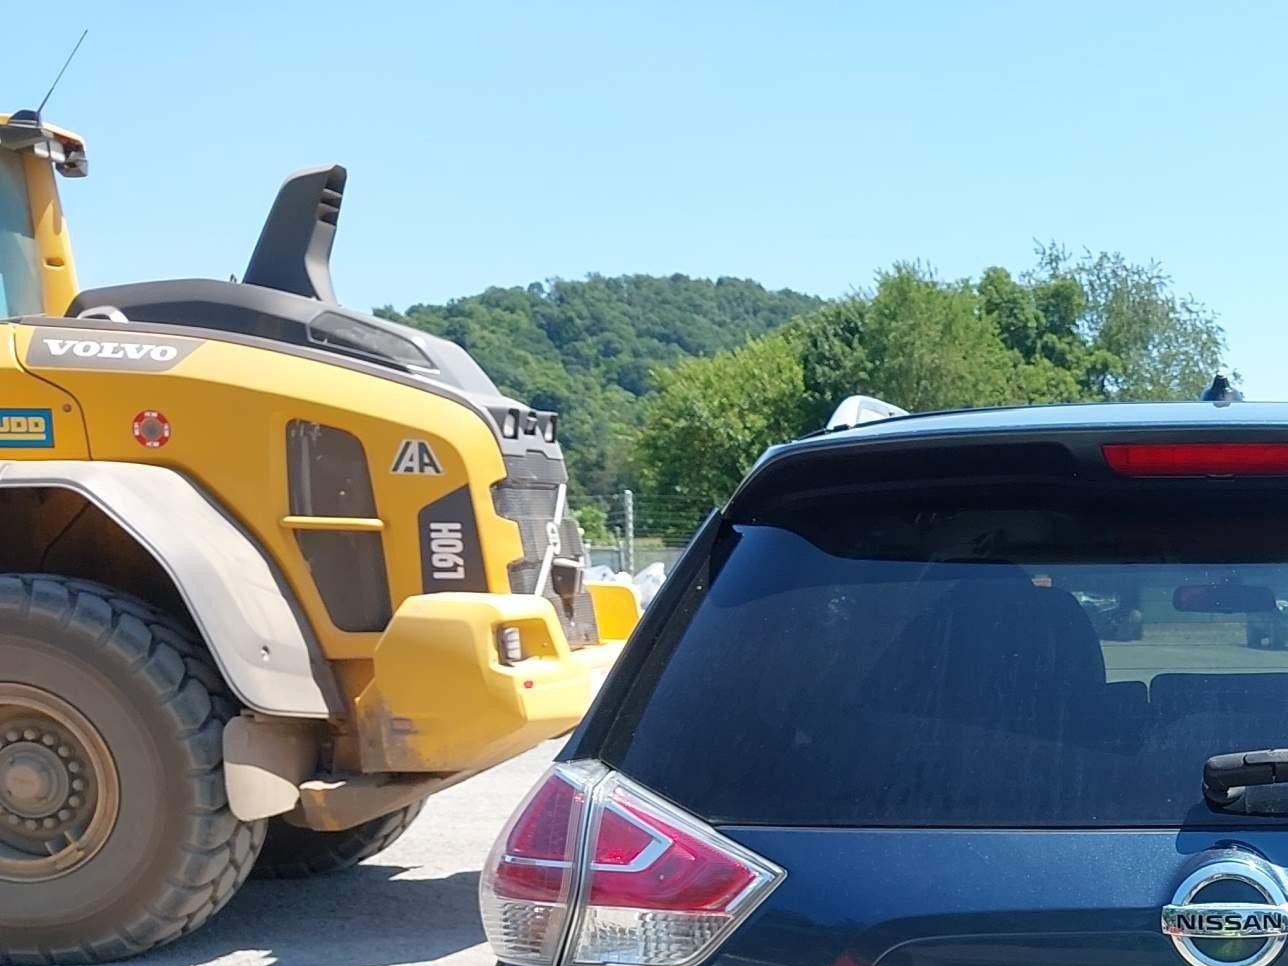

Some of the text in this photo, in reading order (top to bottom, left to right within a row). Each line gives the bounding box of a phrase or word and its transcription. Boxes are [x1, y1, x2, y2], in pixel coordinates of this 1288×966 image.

[42, 338, 178, 362] VOLVO
[428, 522, 466, 581] L90H
[1176, 912, 1283, 932] NISSAN
